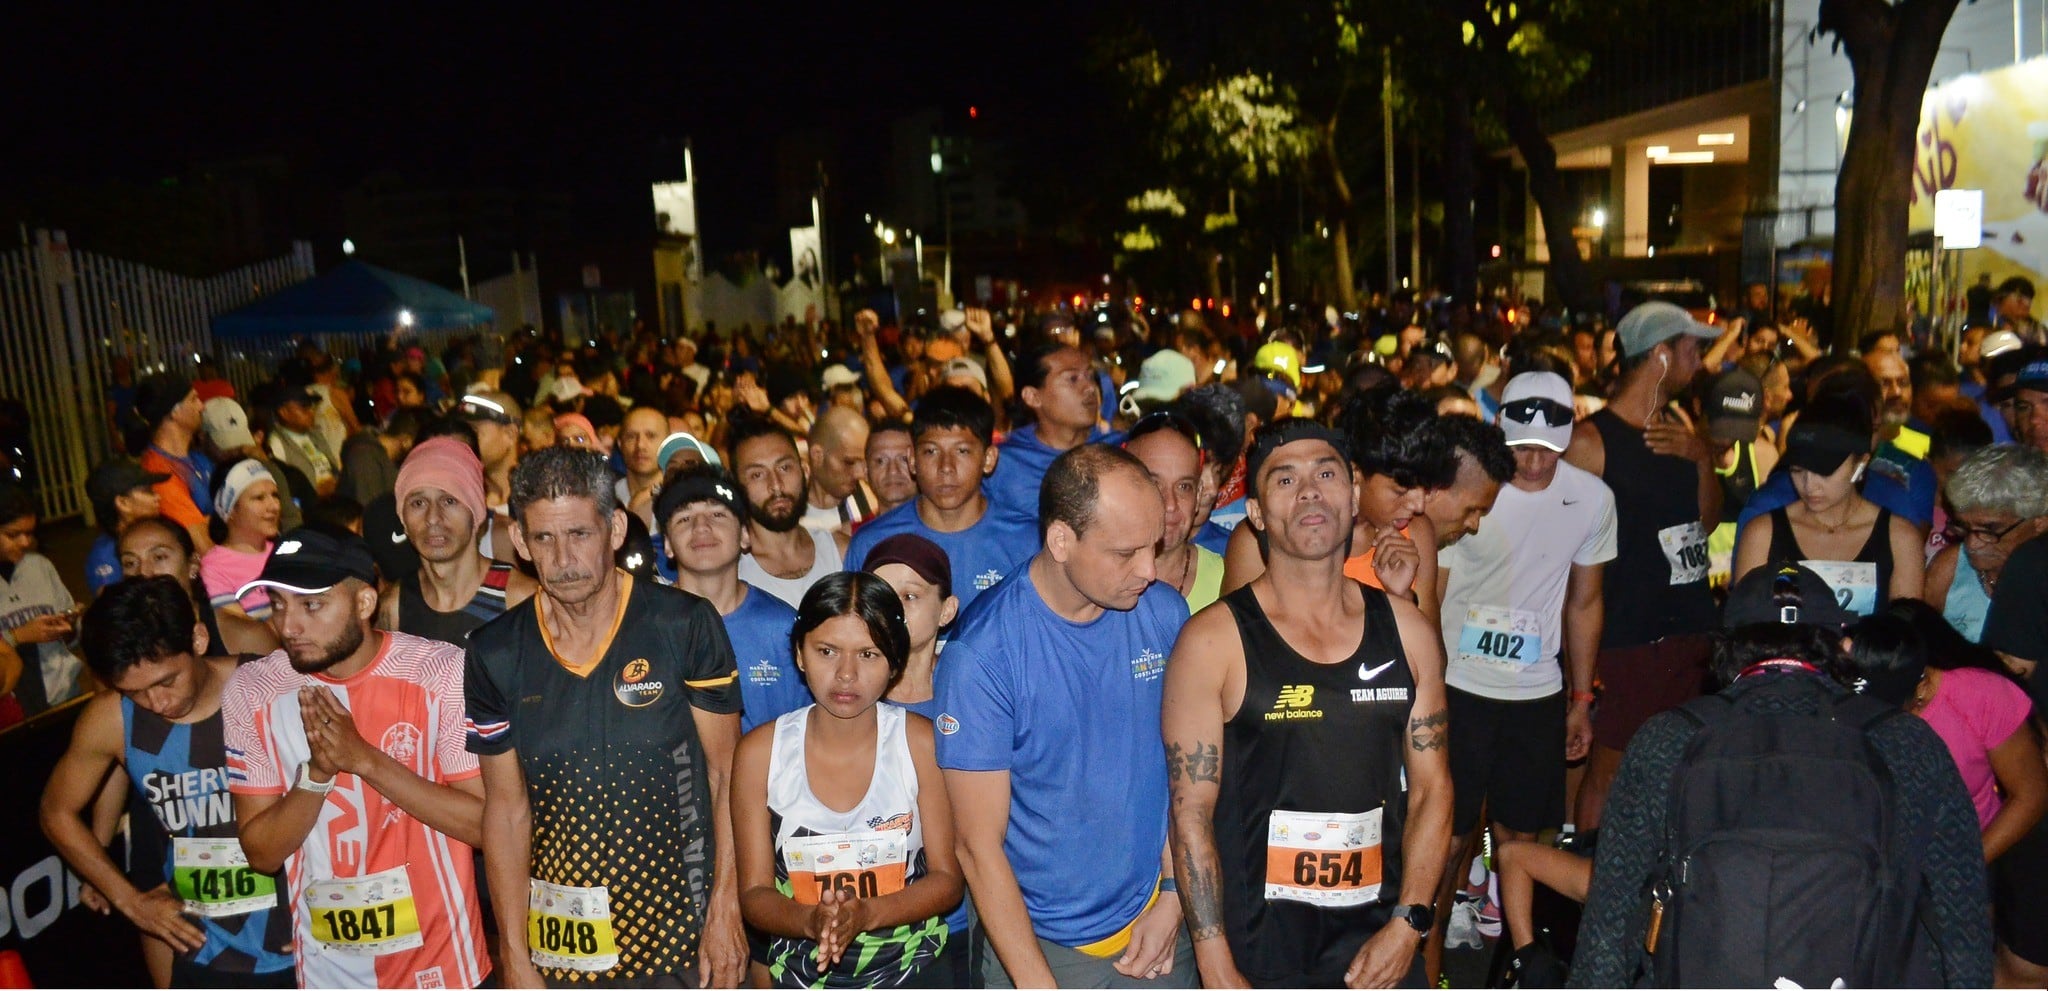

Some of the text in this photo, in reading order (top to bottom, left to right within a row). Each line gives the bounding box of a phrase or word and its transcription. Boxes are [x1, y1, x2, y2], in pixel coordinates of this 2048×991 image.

[1676, 541, 1707, 570] 108
[1477, 630, 1525, 660] 402
[618, 681, 663, 693] ALVARADO
[1350, 687, 1408, 702] TEAM AGUIRRE
[1264, 709, 1323, 721] new balance
[672, 740, 699, 832] VIDA
[152, 792, 237, 830] RUNN
[189, 868, 256, 899] 1416
[1293, 850, 1363, 887] 654
[814, 871, 878, 902] 760
[323, 904, 396, 941] 1847
[537, 916, 598, 954] 1848
